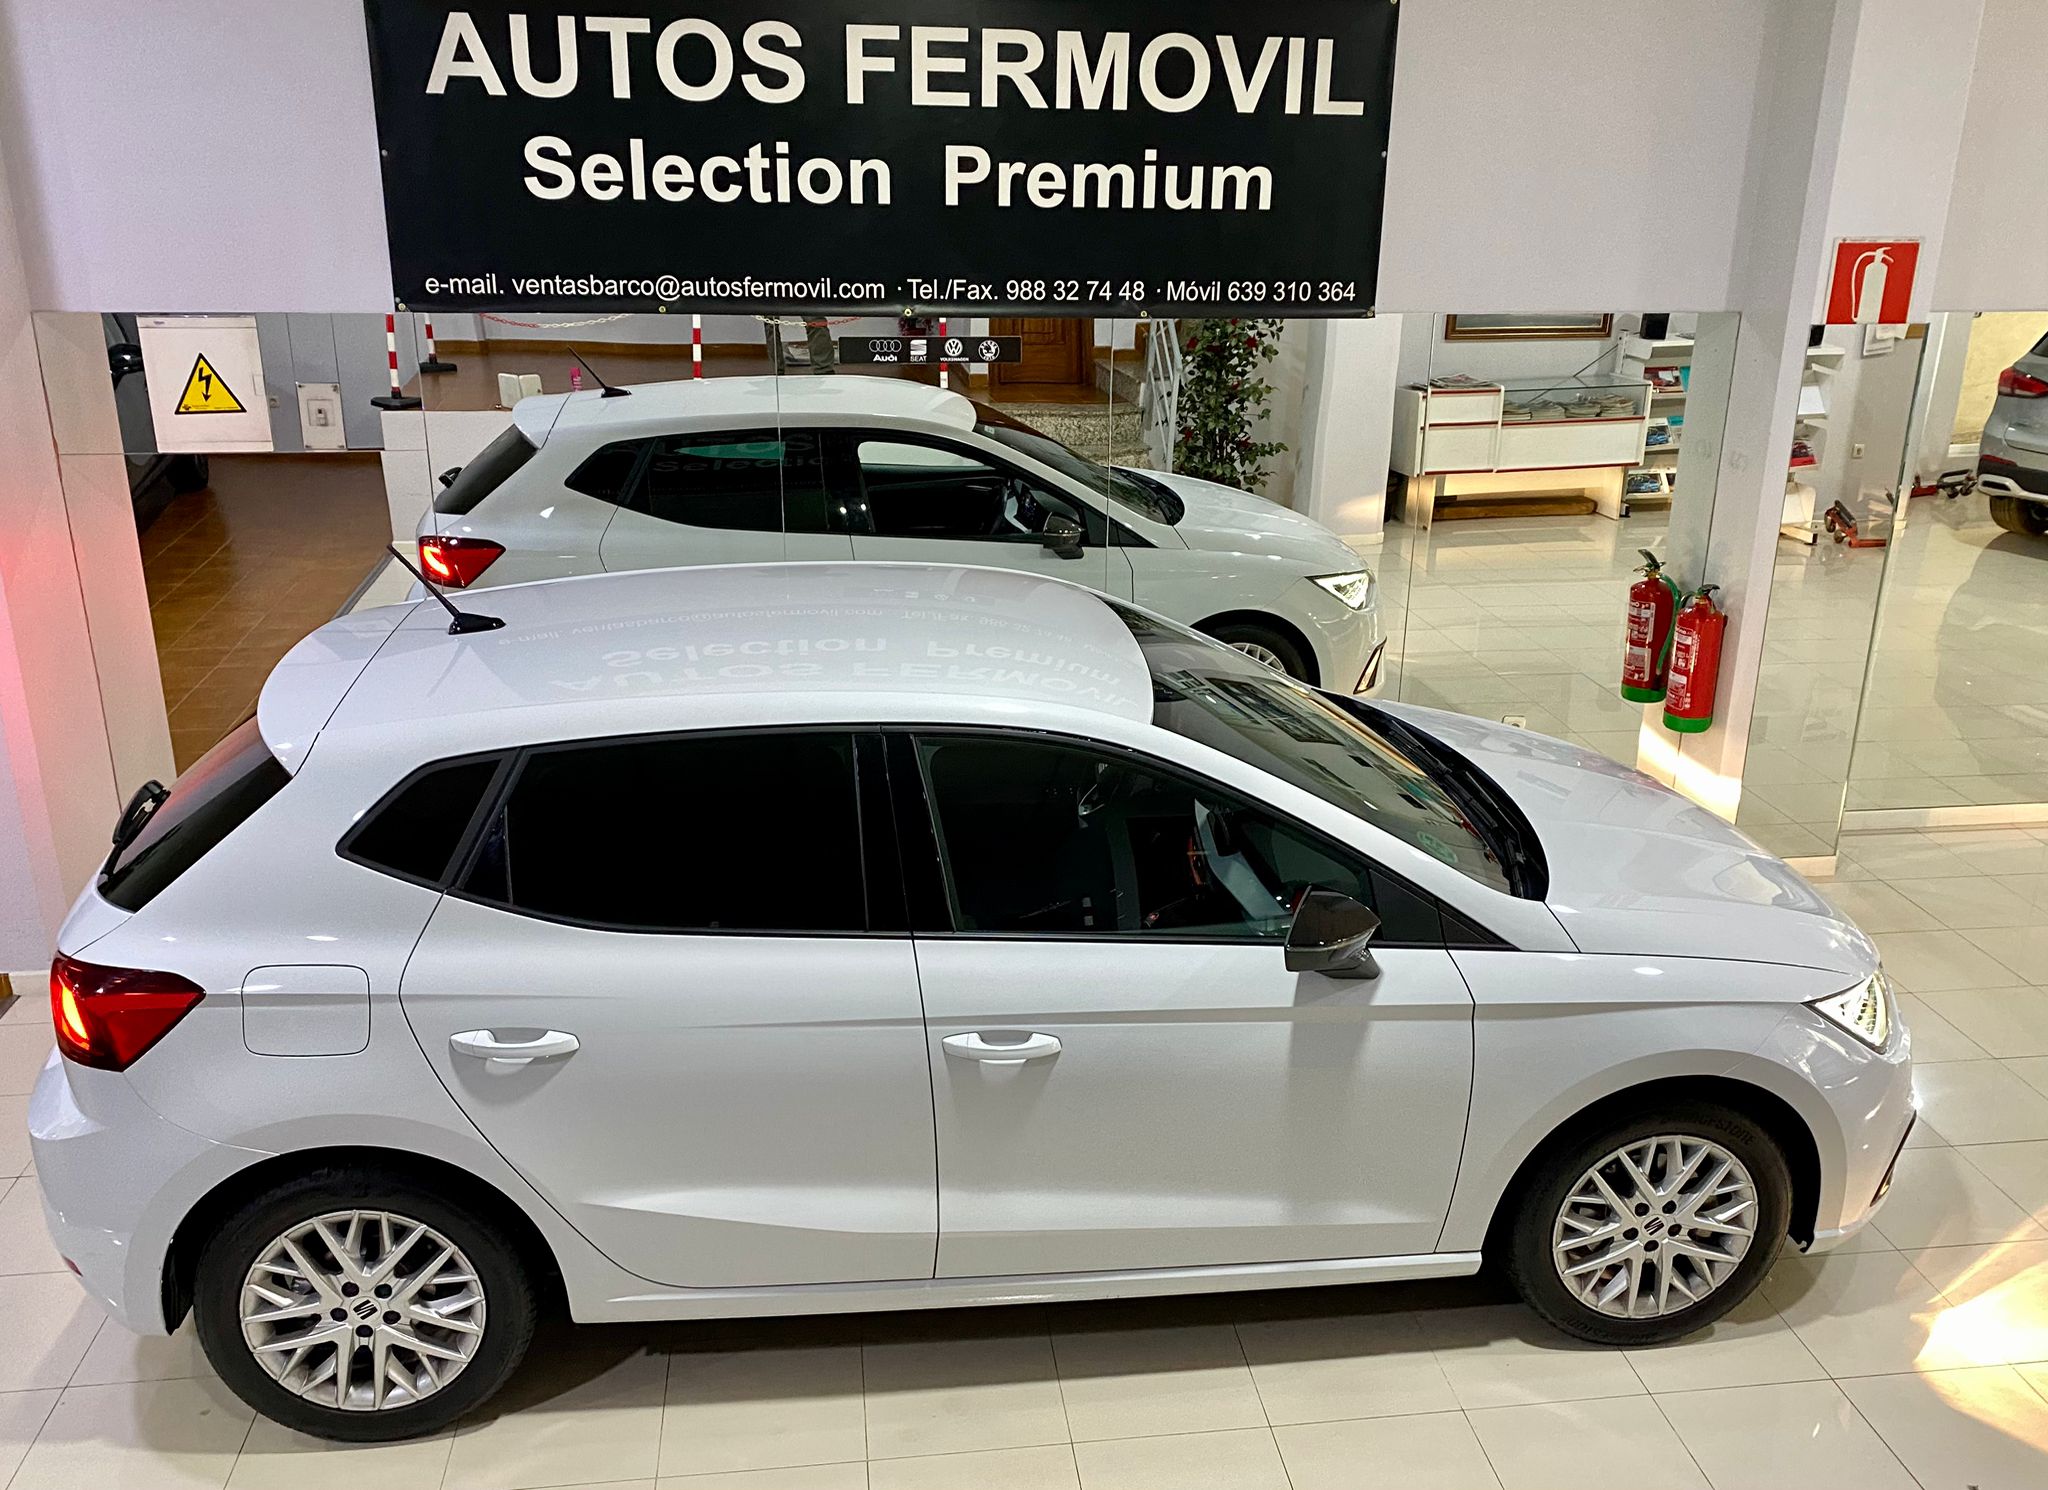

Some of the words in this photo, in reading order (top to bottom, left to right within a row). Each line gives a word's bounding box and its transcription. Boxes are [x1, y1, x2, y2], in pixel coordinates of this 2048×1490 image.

[426, 12, 805, 104] AUTOS
[846, 24, 1364, 116] FERMOVIL
[524, 136, 890, 205] Selection
[946, 145, 1272, 210] Premium
[425, 277, 504, 295] e-mail.
[511, 275, 885, 302] ventasbarco@autosfermovil.com
[1006, 280, 1046, 301] 988
[1053, 280, 1079, 301] 32
[1086, 280, 1113, 301] 74
[1118, 280, 1145, 301] 48
[1227, 281, 1267, 302] 639
[1273, 281, 1312, 302] 310
[1318, 281, 1356, 302] 364
[873, 354, 897, 362] Audi
